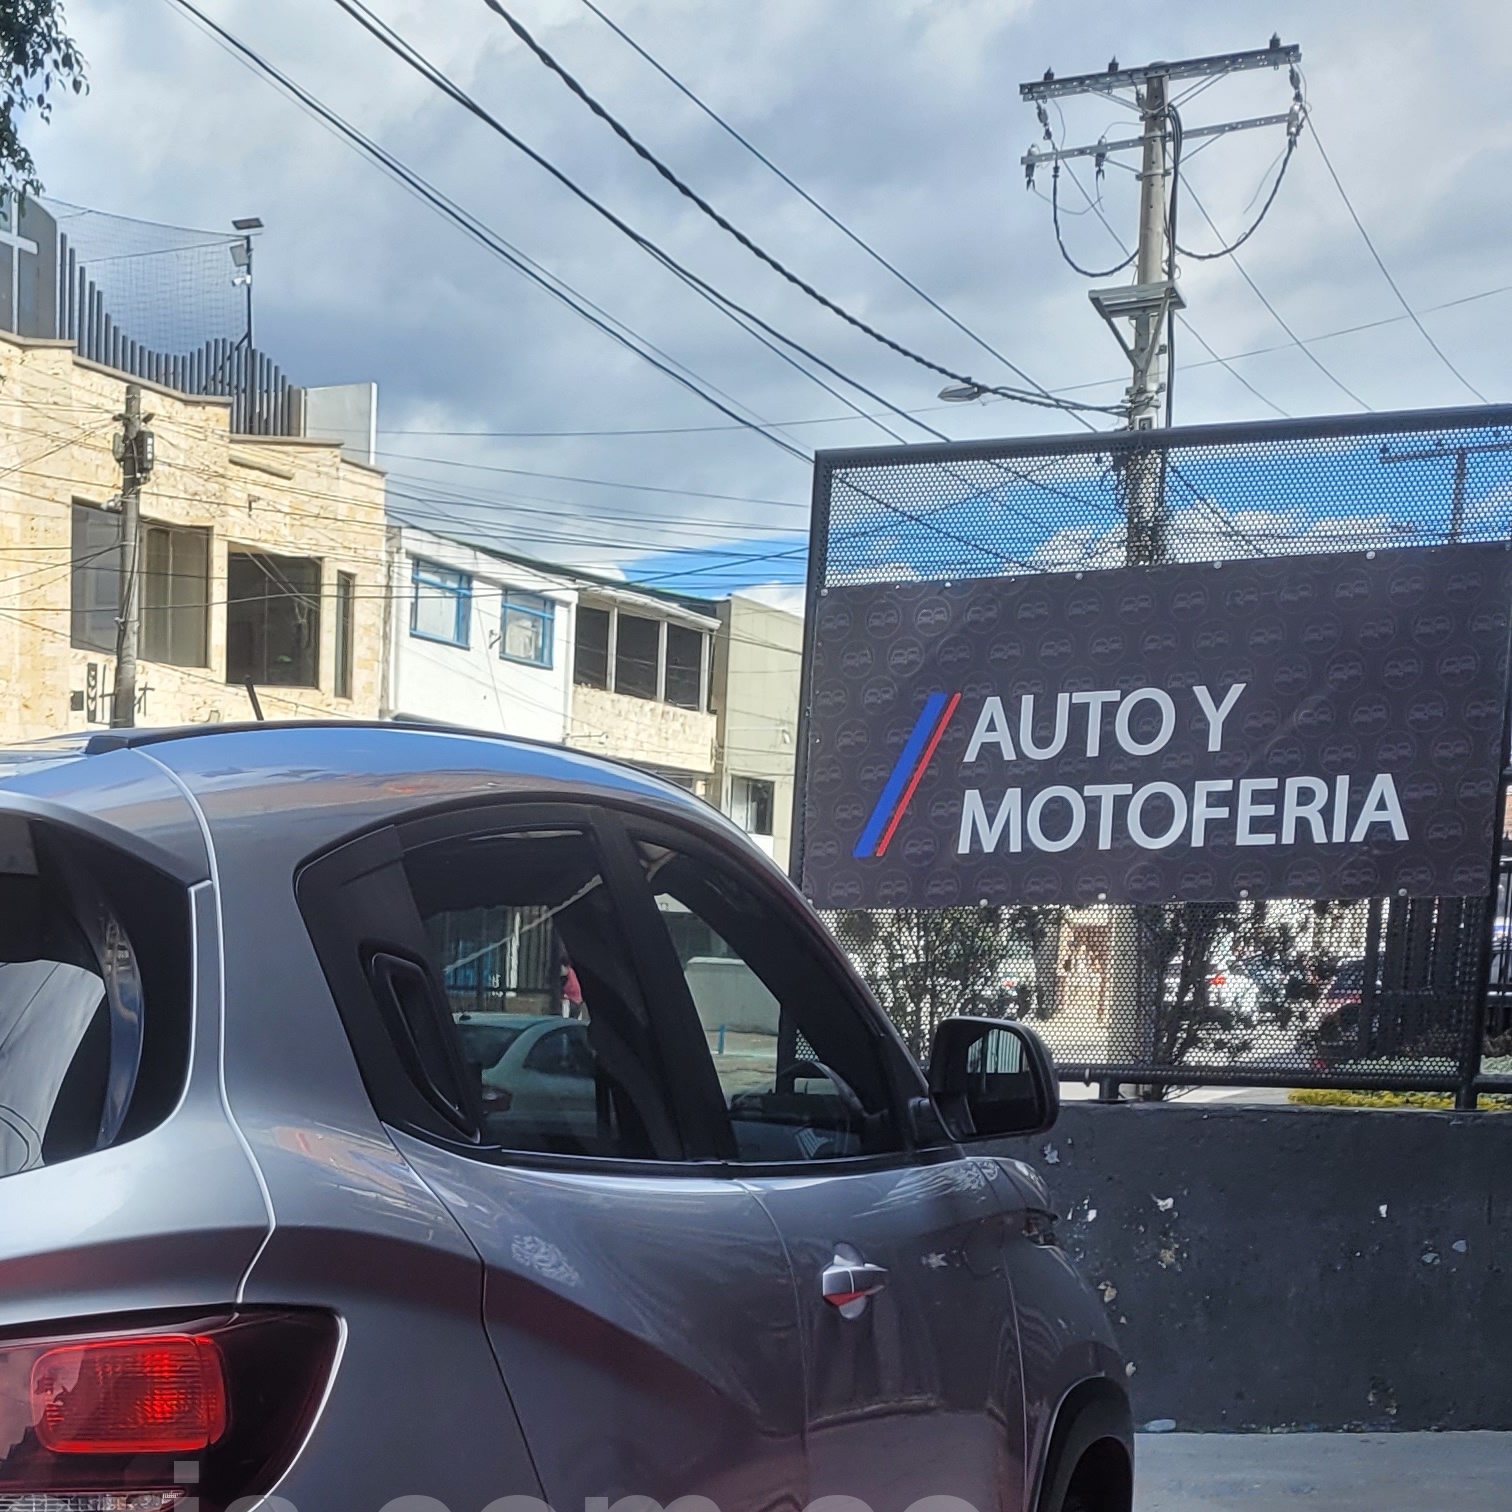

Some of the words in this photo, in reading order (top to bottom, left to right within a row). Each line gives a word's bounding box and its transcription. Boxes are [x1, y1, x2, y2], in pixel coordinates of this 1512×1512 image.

[964, 688, 1176, 762] AUTO
[1192, 683, 1247, 752] Y
[957, 773, 1409, 855] MOTOFERIA
